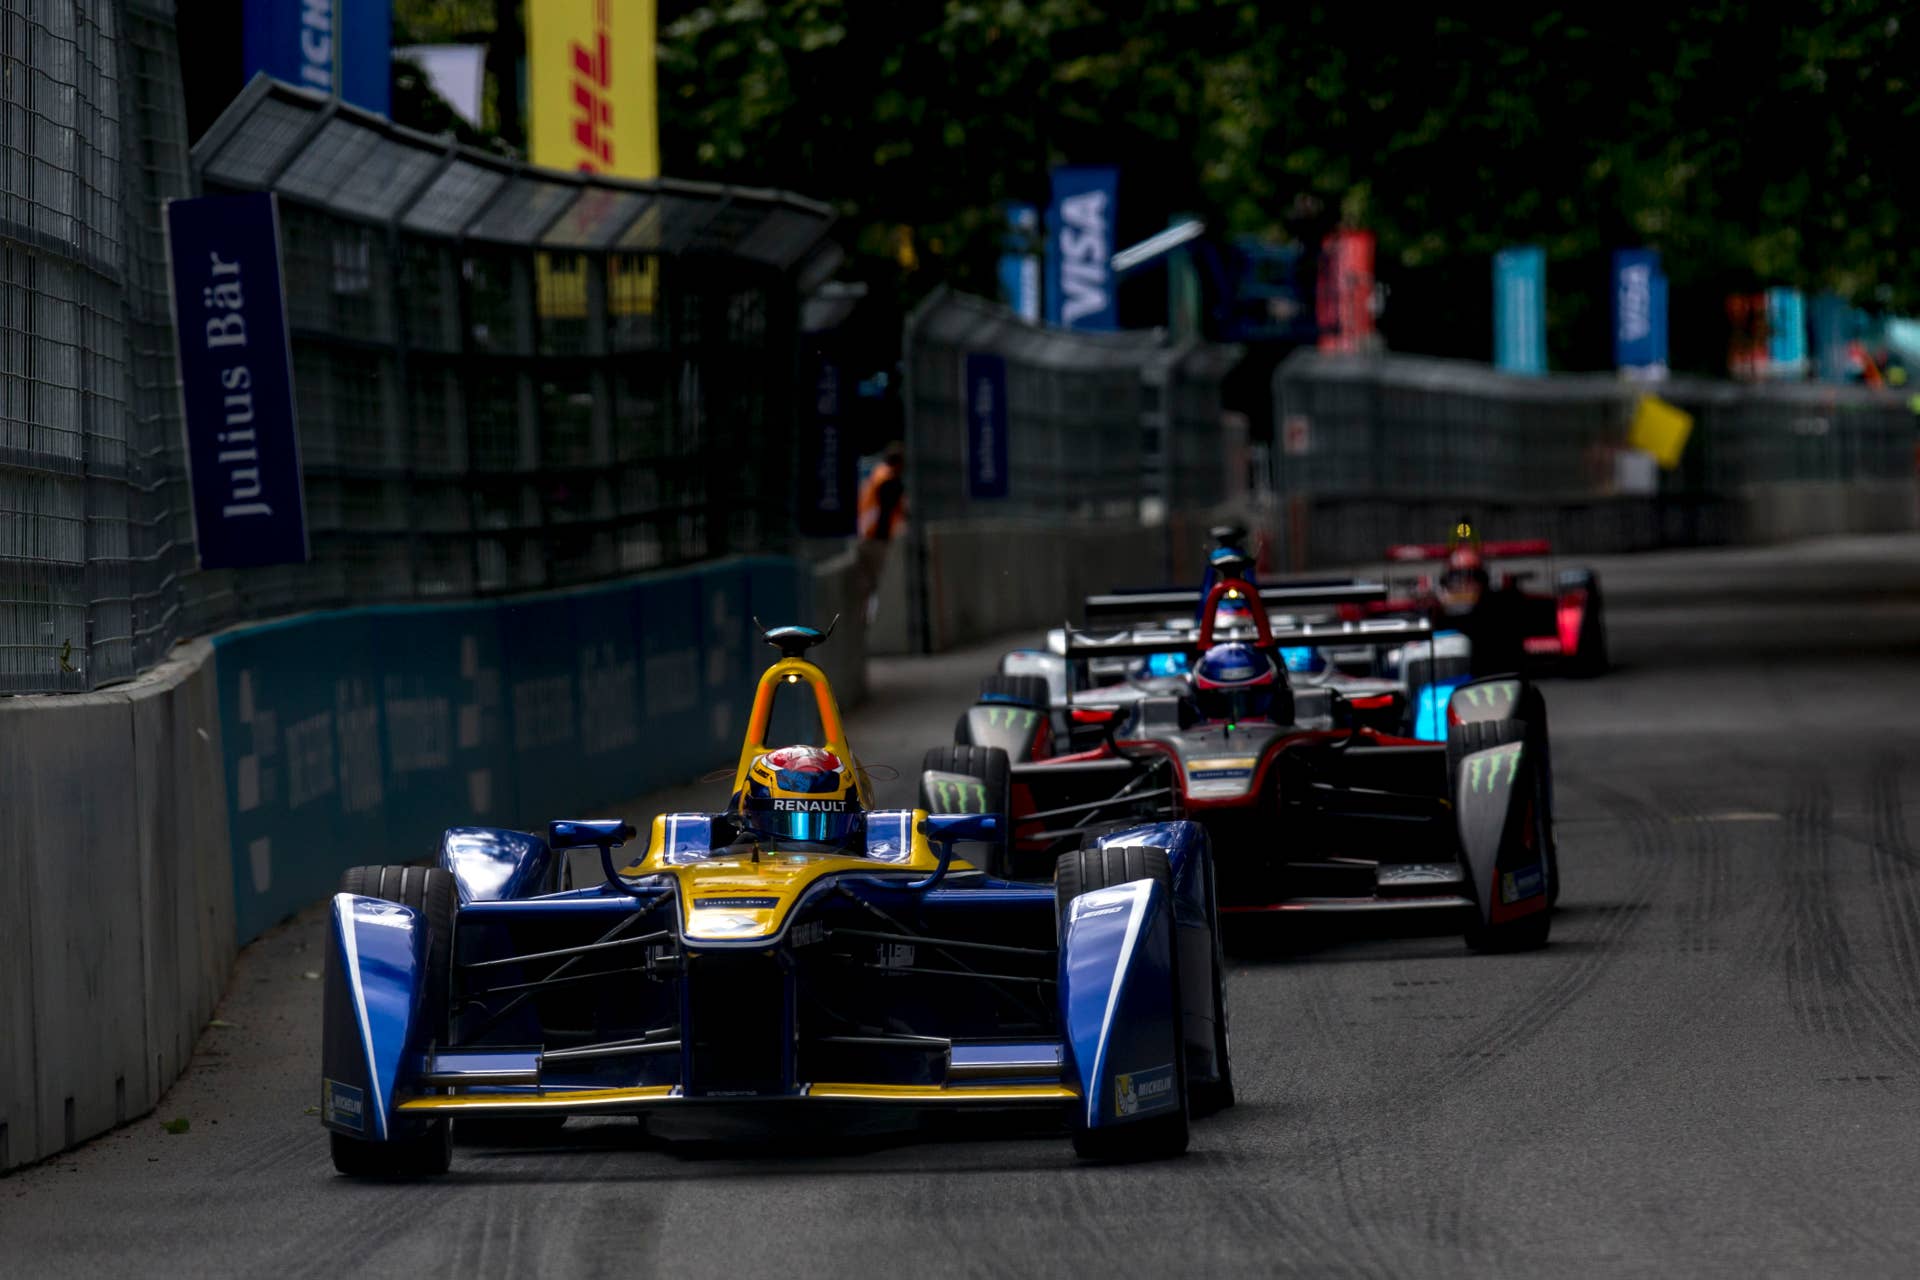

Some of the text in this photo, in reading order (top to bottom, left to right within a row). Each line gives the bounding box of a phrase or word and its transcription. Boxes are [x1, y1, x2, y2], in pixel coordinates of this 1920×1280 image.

[572, 32, 612, 175] HL
[1058, 188, 1108, 330] VISA
[204, 250, 274, 519] Julius Bär
[773, 799, 848, 813] RENAULT
